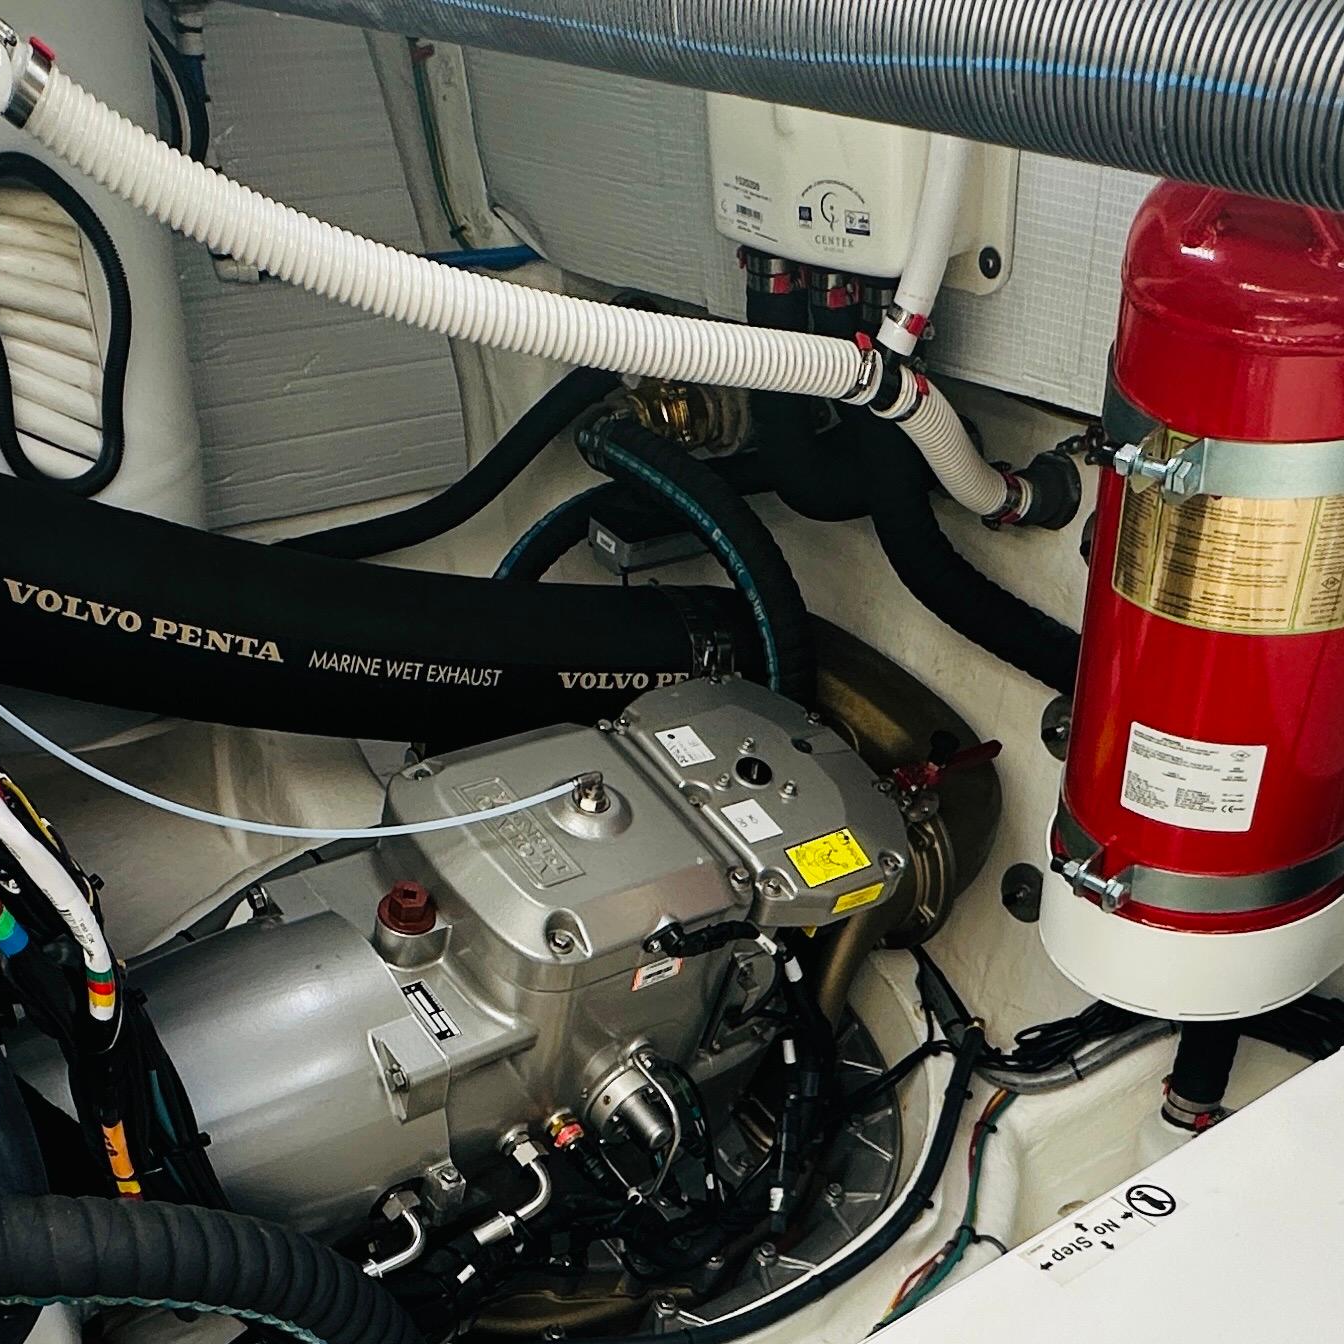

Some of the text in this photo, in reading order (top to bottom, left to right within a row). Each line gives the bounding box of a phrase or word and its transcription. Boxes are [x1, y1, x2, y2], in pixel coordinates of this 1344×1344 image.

[815, 235, 854, 248] CENTEK
[3, 578, 504, 689] VOLVO PENTA MARINE WET EXHAUST
[557, 671, 650, 690] VOLVO
[1049, 1216, 1120, 1265] No Step
